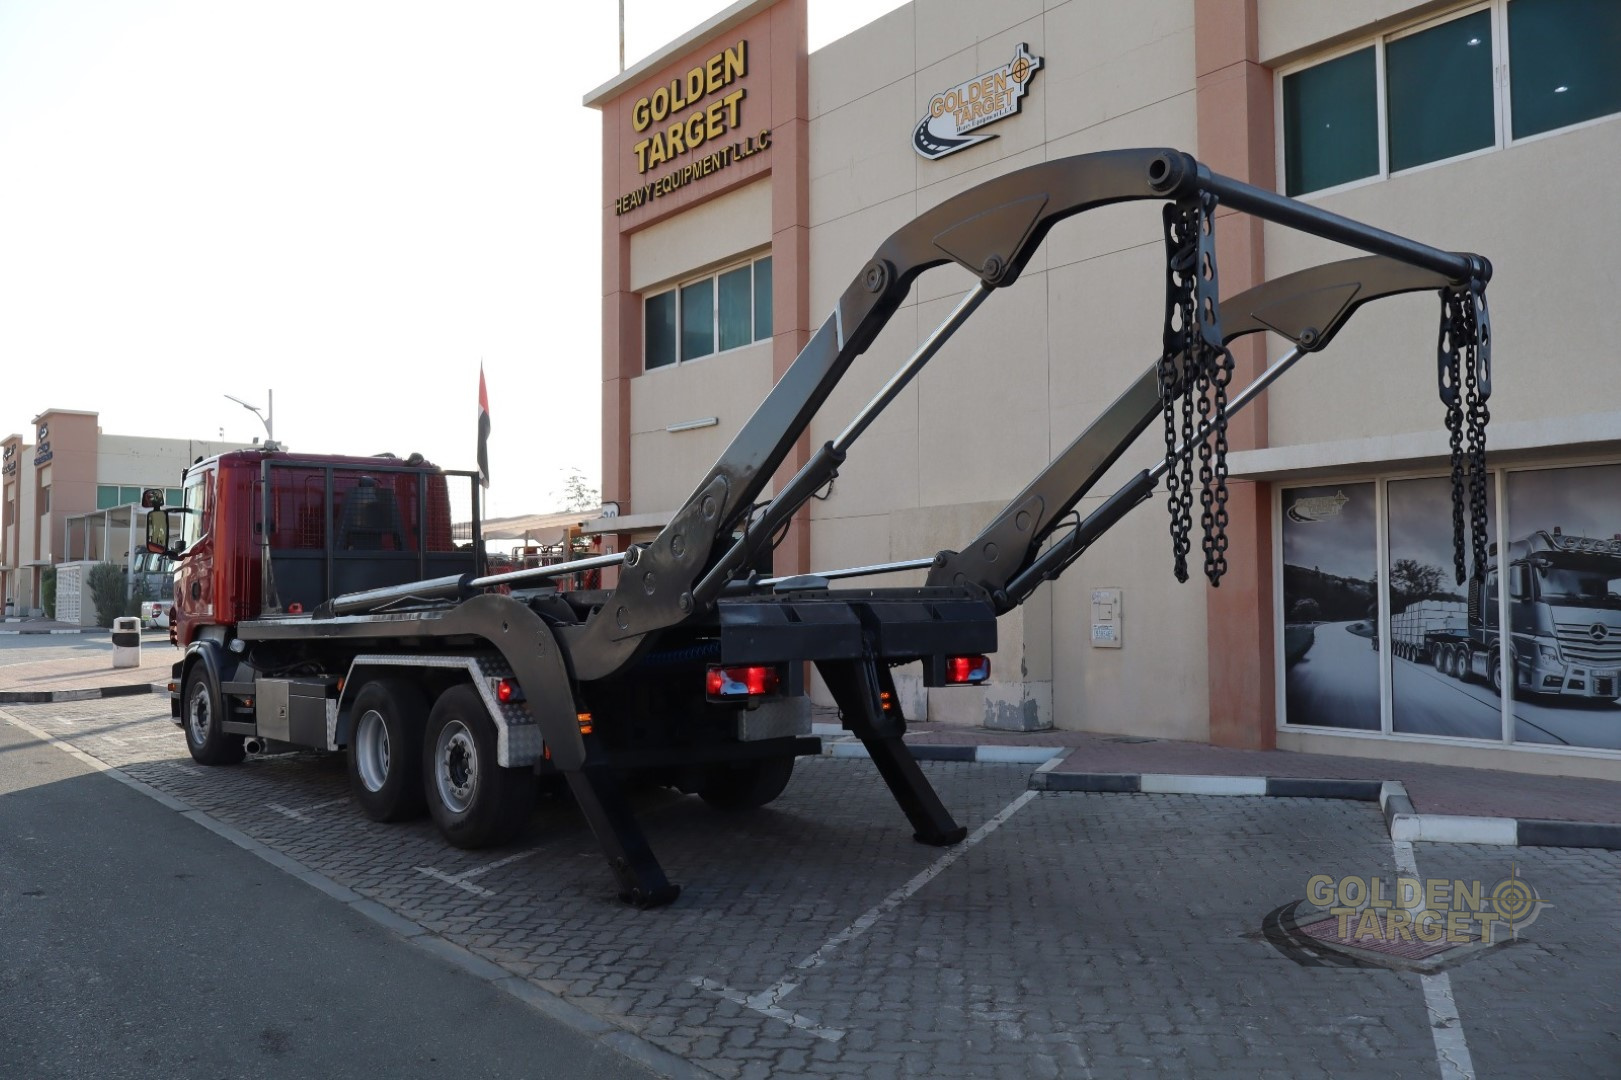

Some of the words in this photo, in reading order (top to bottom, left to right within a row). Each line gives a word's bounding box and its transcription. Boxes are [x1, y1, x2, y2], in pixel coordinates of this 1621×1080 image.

[632, 39, 747, 133] GOLDEN
[930, 69, 1007, 118] GOLDEN
[953, 86, 1015, 127] TARGET
[615, 183, 654, 216] HEAVY
[655, 146, 731, 197] EQUIPMENT
[733, 129, 771, 161] L.L.C
[633, 88, 745, 174] TARGET
